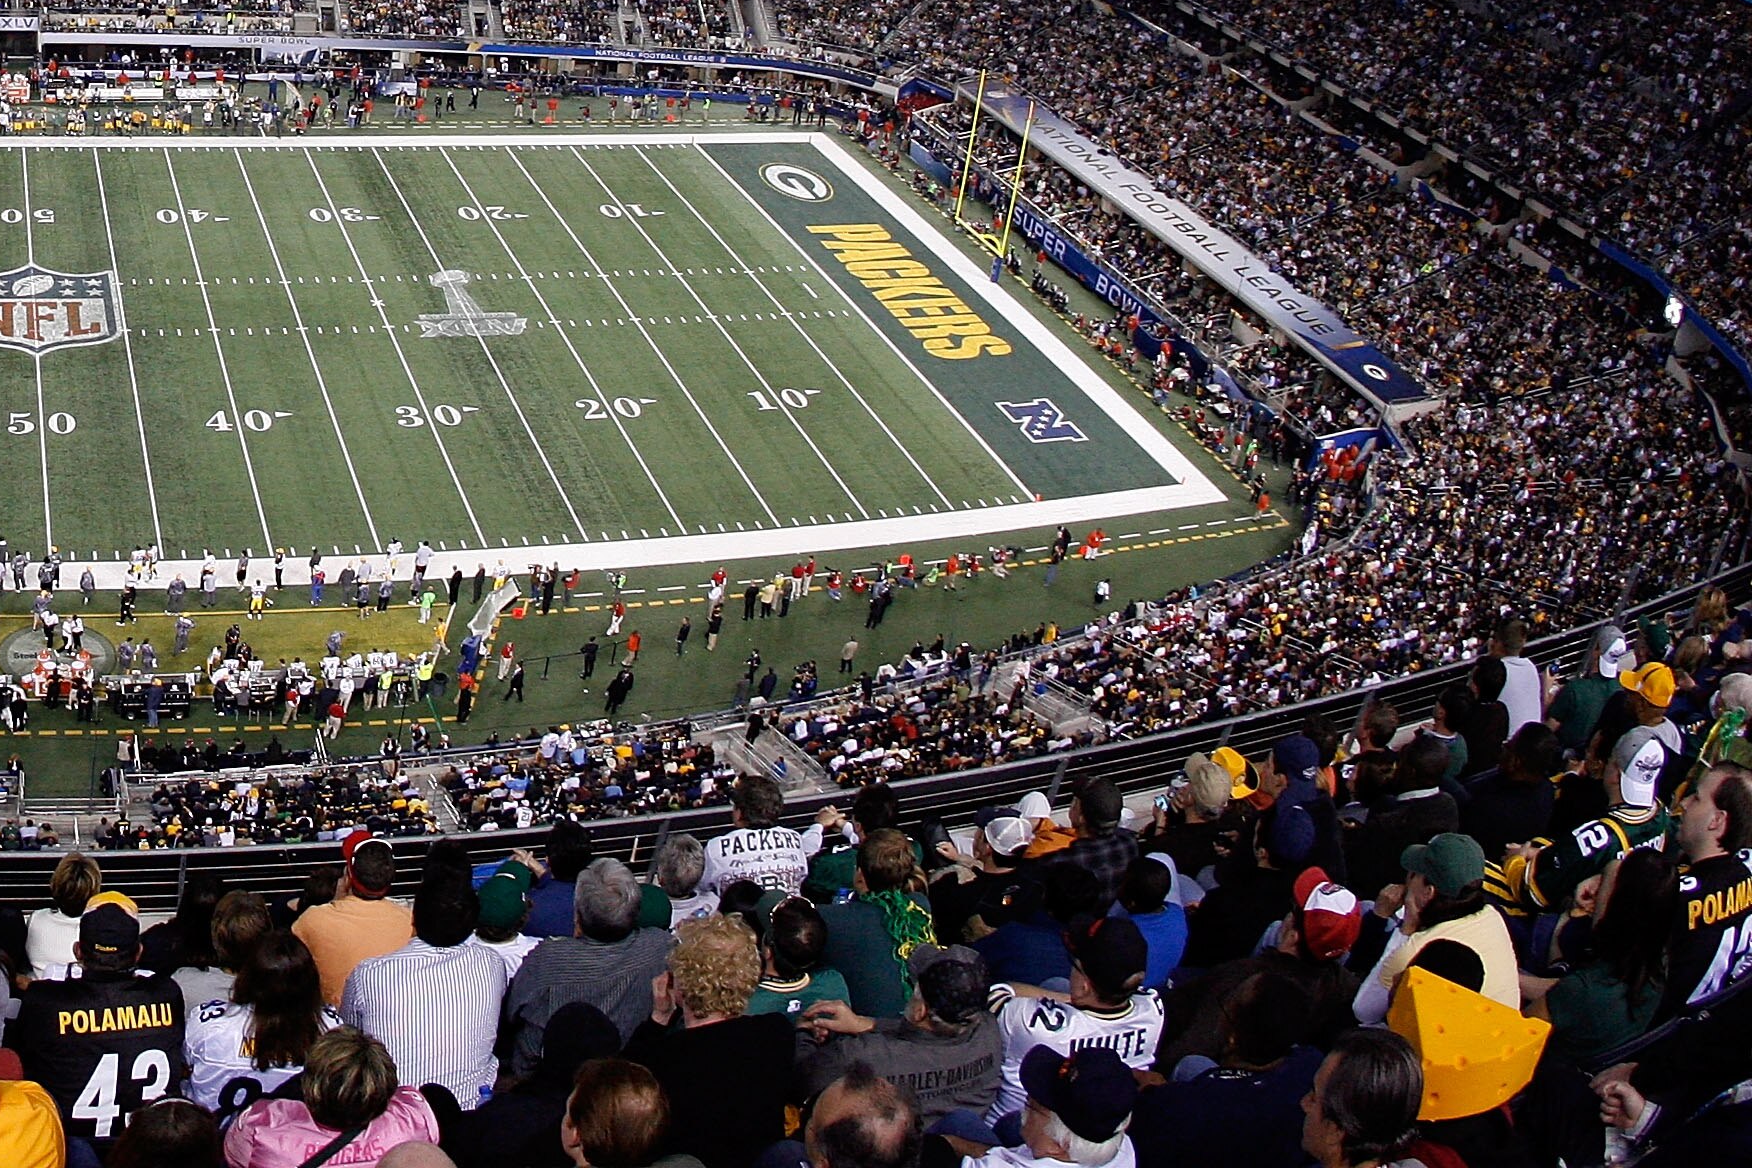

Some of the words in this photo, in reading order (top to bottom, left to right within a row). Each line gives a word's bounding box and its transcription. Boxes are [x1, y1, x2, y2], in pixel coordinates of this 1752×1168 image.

[0, 17, 36, 29] XLV
[594, 49, 636, 58] NATIONAL
[638, 51, 681, 61] FOOTBALL
[682, 53, 716, 63] LEAGUE
[1012, 205, 1068, 262] SUPER
[1029, 117, 1122, 181] NATIONAL
[1118, 183, 1234, 263] FOOTBALL
[1232, 265, 1336, 337] LEAGUE
[805, 223, 1013, 360] PACKERS
[574, 396, 642, 420] 20
[747, 387, 810, 412] 10
[6, 411, 78, 435] 50
[205, 409, 273, 432] 40
[394, 404, 463, 428] 30
[720, 828, 801, 857] PACKERS
[58, 1002, 173, 1035] POLAMALU
